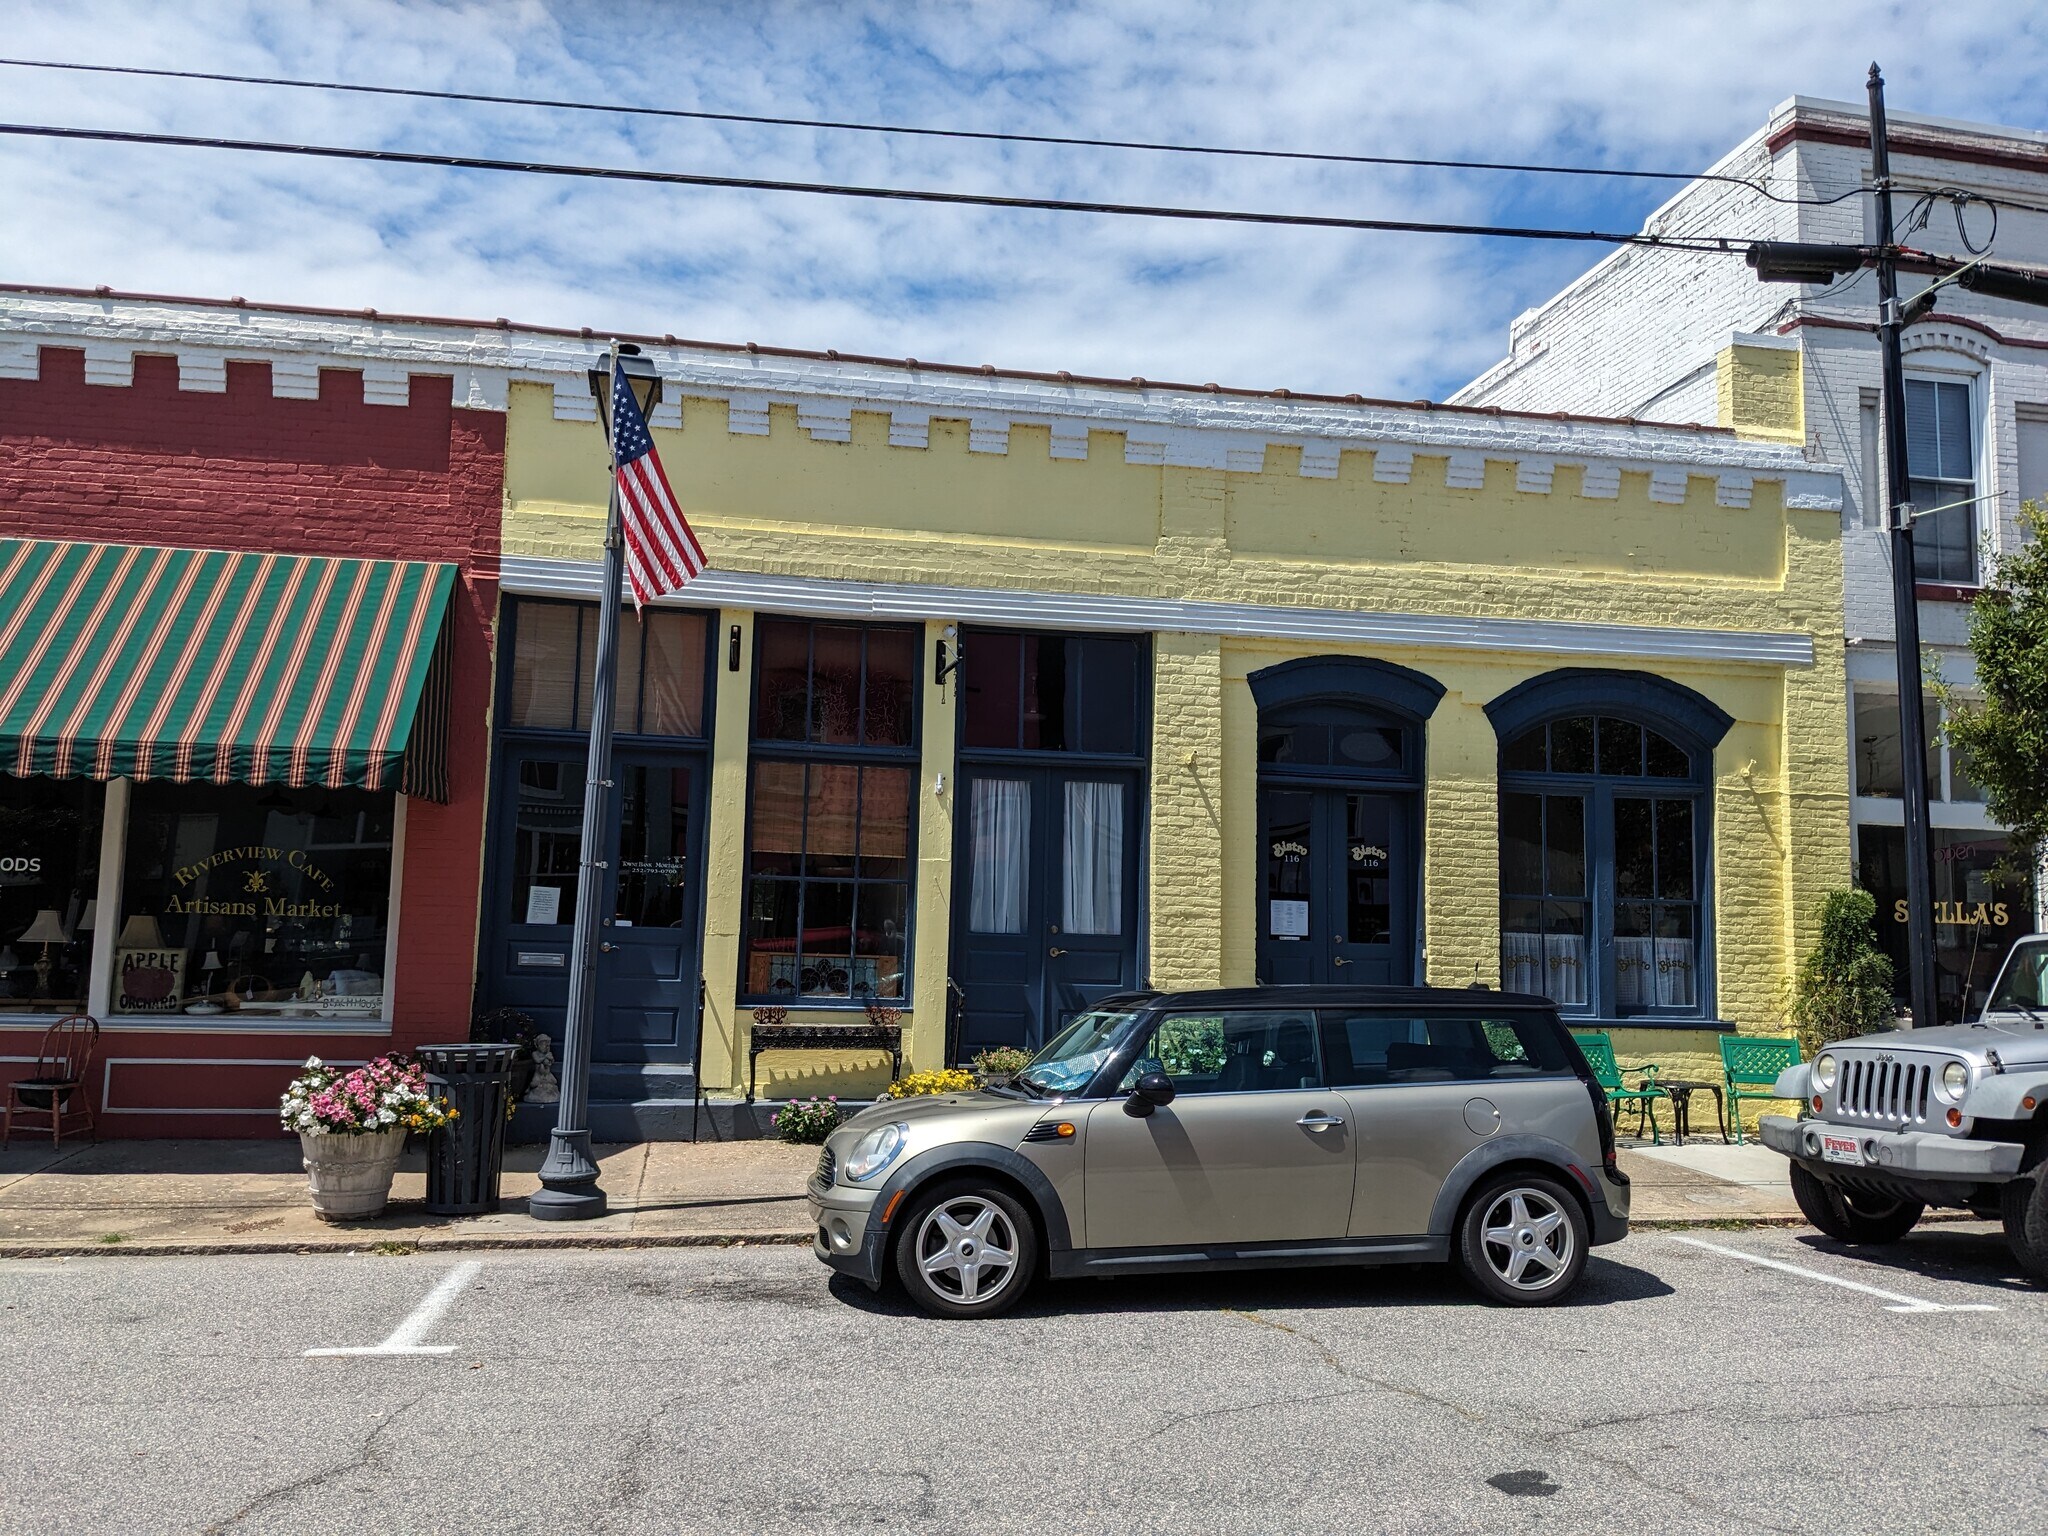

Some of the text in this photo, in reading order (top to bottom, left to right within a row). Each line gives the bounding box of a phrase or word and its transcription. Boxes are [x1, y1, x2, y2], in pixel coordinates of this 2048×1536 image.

[1272, 841, 1308, 858] Bistro
[1351, 845, 1387, 861] Bistro
[1933, 846, 1976, 865] open
[1284, 855, 1300, 863] 116
[1363, 859, 1379, 867] 116
[164, 894, 342, 918] Artisans Market
[1893, 899, 2010, 926] SLLA'S
[121, 952, 179, 976] APPLE
[1506, 953, 1583, 970] Bistro Bistro
[1617, 956, 1692, 974] Bistro Bistro
[119, 994, 177, 1010] ORCHARD
